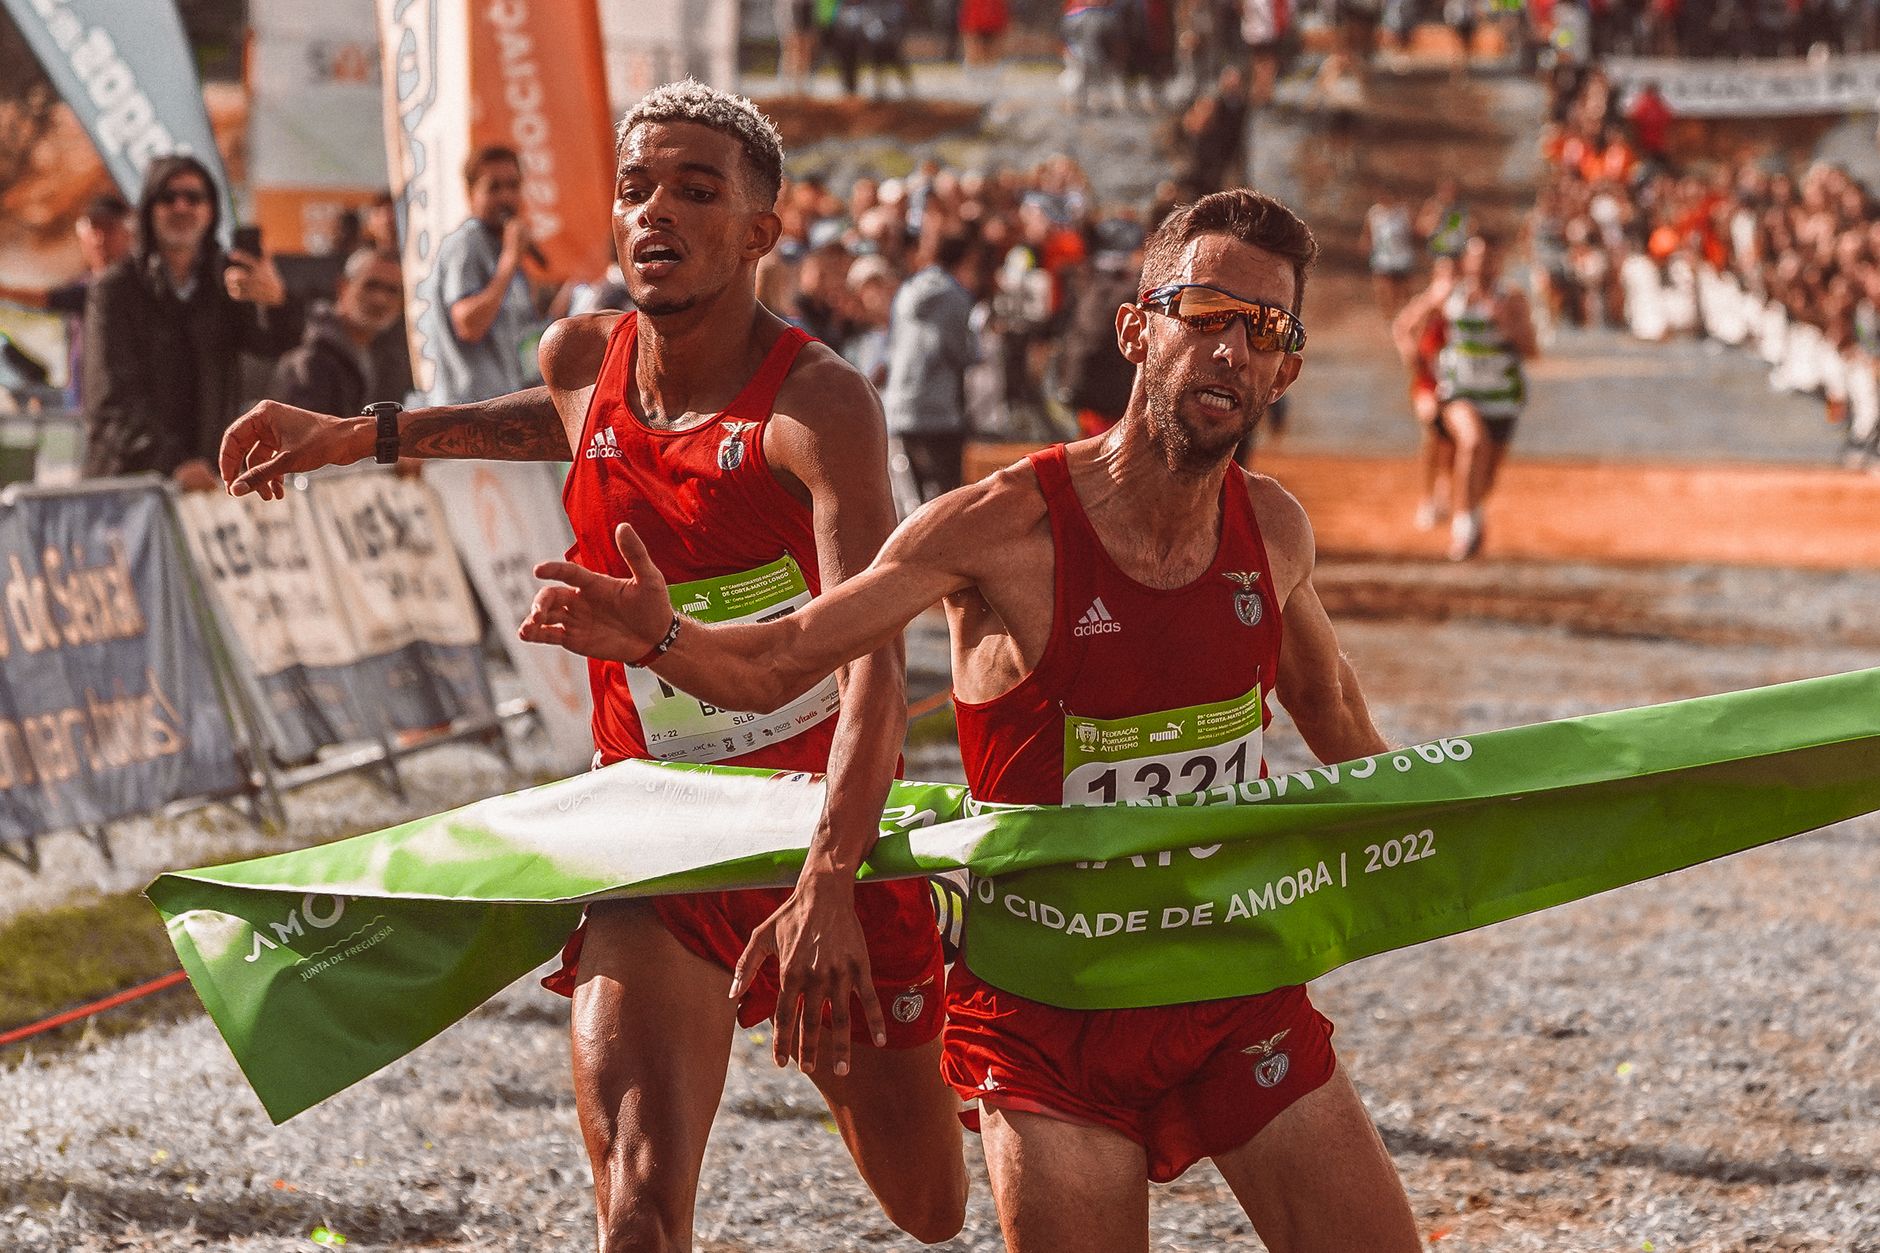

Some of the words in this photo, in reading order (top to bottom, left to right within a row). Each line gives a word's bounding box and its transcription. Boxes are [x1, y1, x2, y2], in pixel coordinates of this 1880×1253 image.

[586, 445, 623, 459] adidas
[1073, 620, 1121, 637] adidas
[733, 713, 755, 726] SLB
[795, 711, 818, 725] Vitalis
[651, 733, 661, 742] 21
[668, 729, 678, 738] 22
[1100, 742, 1139, 753] ATLETISMO
[1088, 741, 1248, 804] 1321
[1003, 894, 1149, 939] CIDADE
[1160, 901, 1215, 930] DE
[1224, 860, 1333, 924] AMORA
[1363, 829, 1437, 874] 2022
[245, 893, 359, 963] AMO
[300, 960, 331, 983] JUNTA
[331, 951, 346, 966] DE
[344, 924, 395, 958] FREGUESIA
